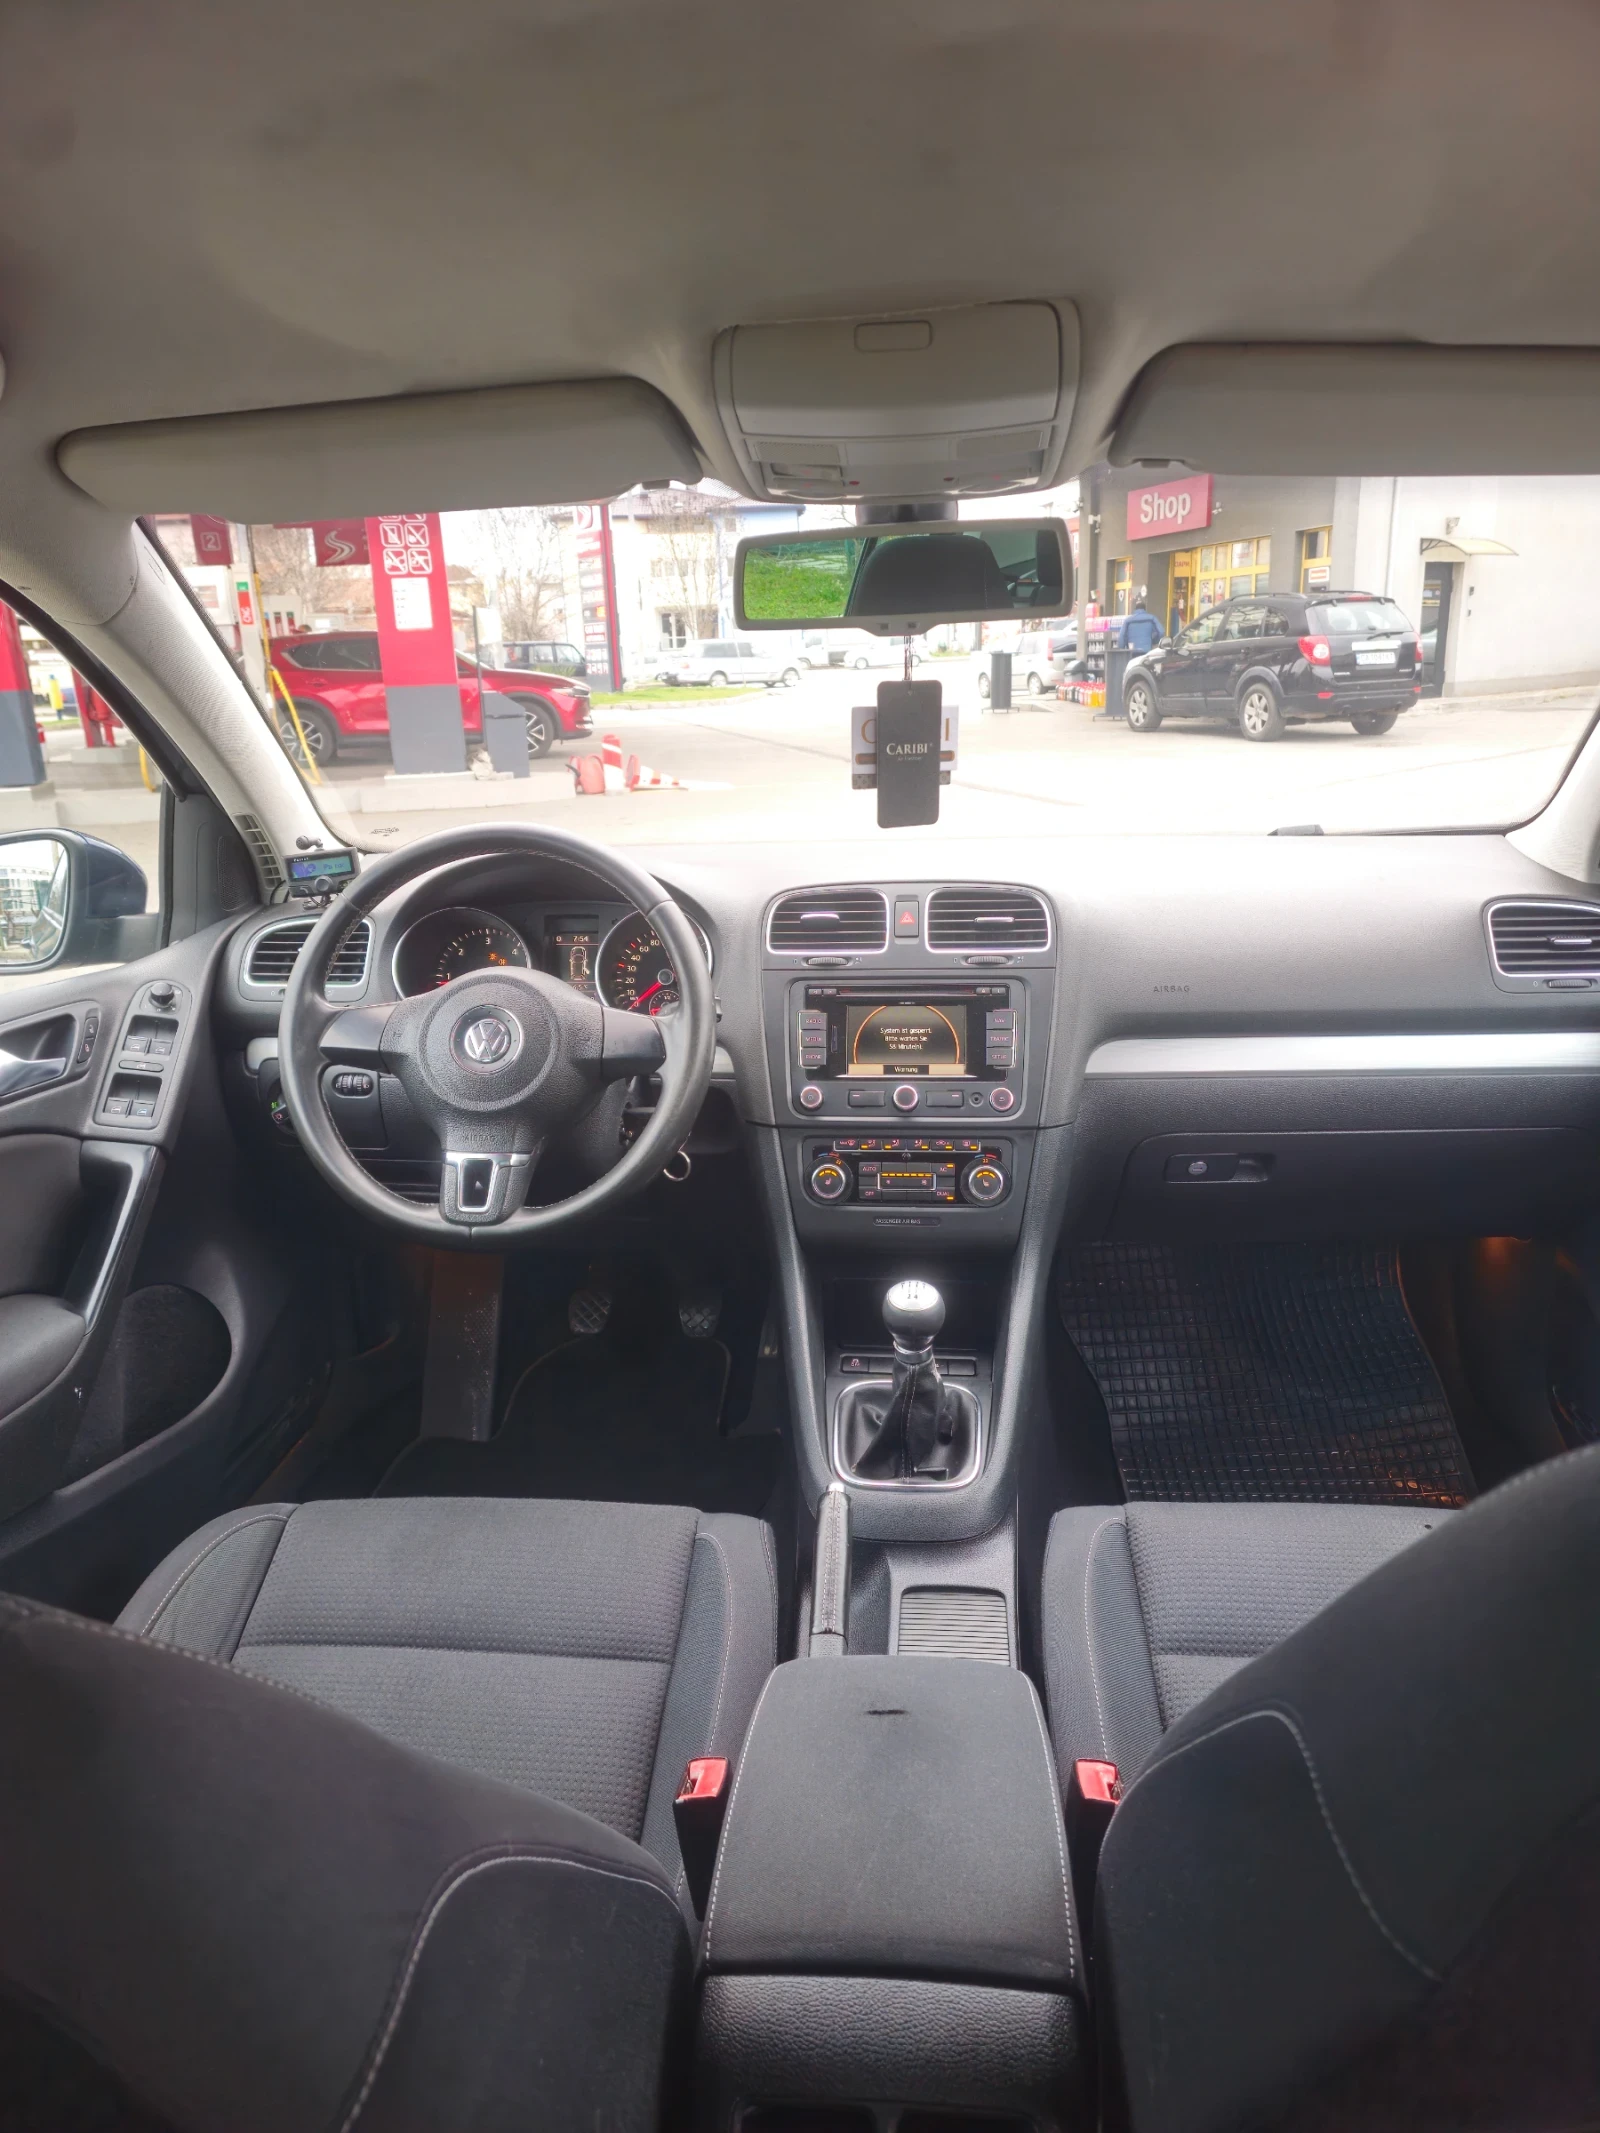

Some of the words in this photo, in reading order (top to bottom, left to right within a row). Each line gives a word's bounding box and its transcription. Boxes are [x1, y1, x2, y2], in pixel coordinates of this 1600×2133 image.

[1140, 492, 1191, 525] Shop
[206, 534, 216, 549] 2
[886, 743, 928, 755] CARIBI
[458, 948, 464, 956] 2
[1153, 985, 1190, 993] AIRBAG
[880, 1027, 900, 1035] System
